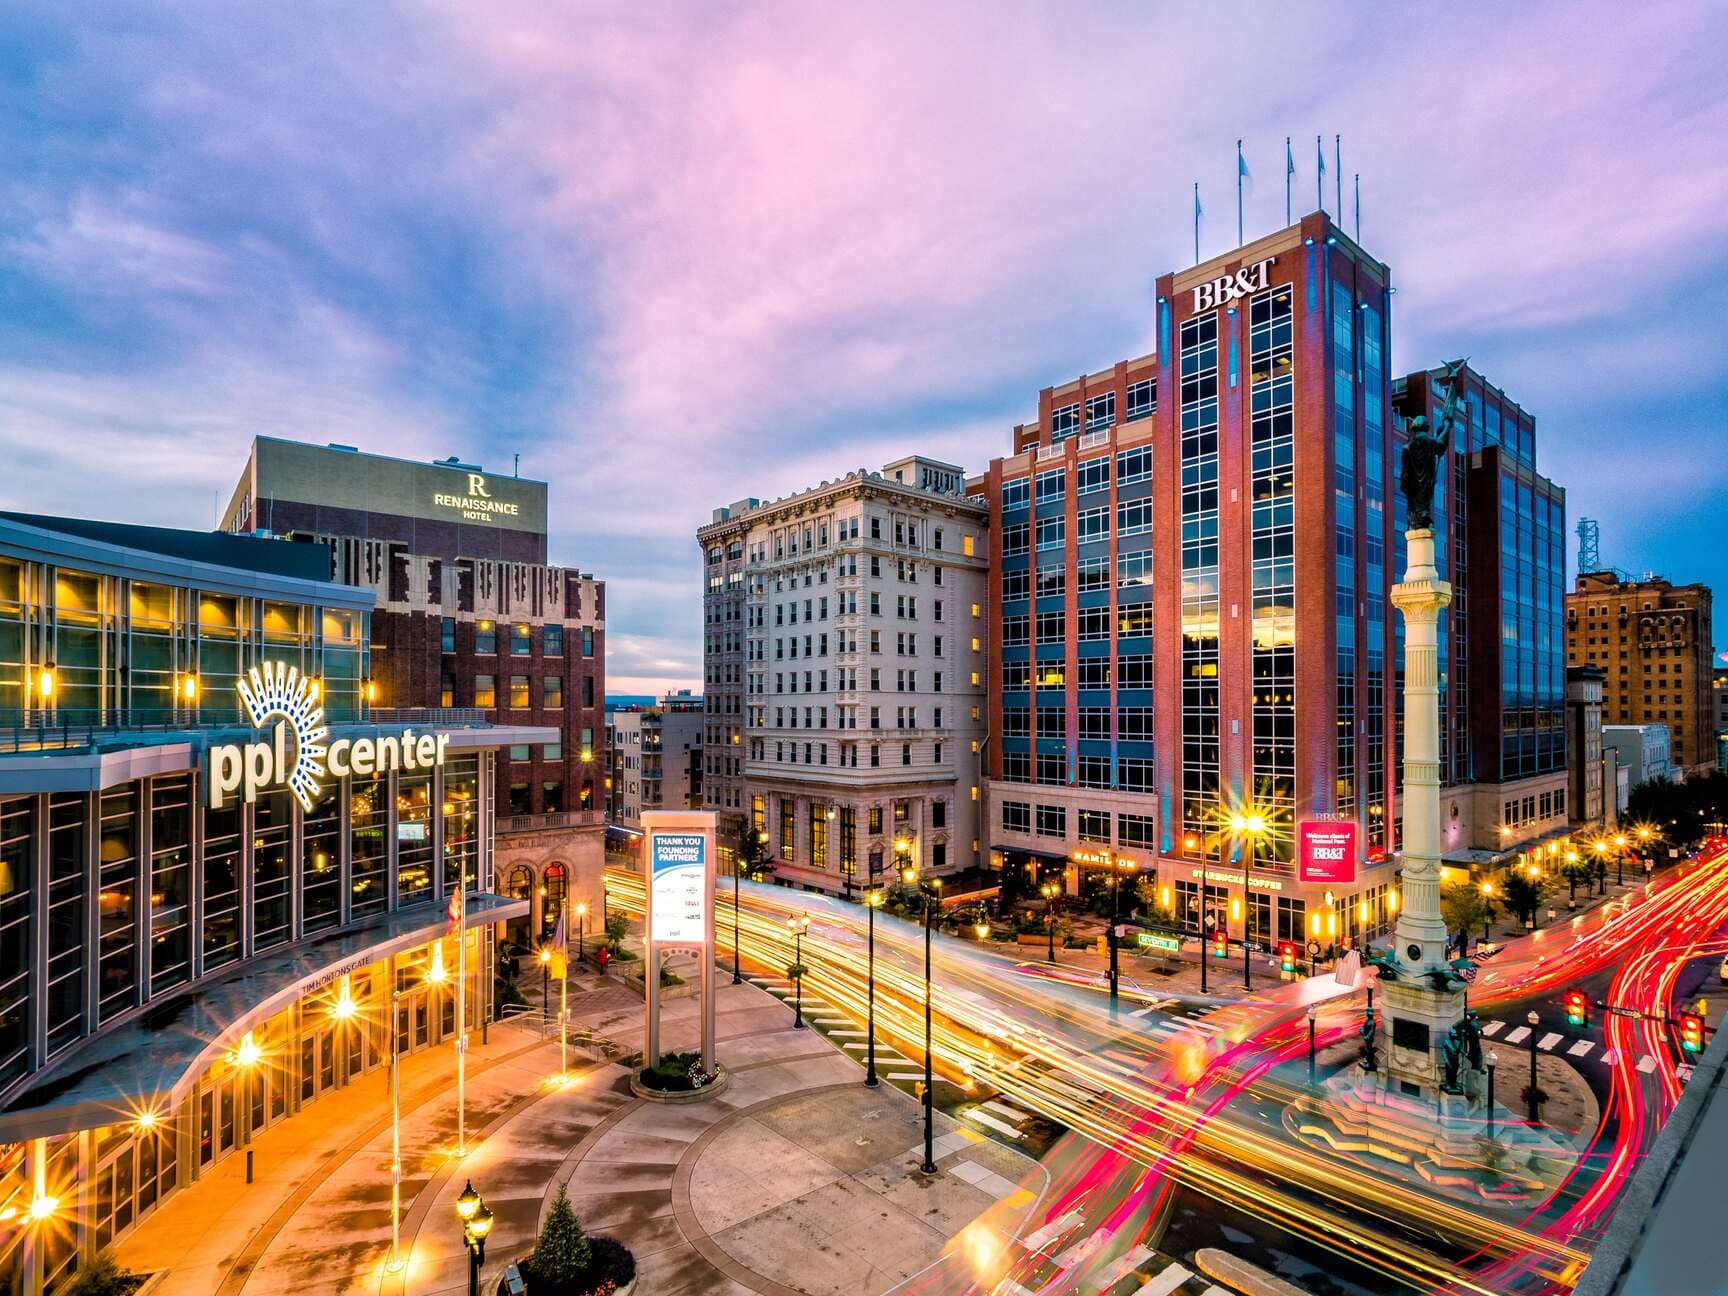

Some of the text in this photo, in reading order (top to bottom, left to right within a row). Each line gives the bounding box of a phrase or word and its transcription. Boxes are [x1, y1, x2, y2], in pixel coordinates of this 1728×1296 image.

[1192, 257, 1276, 314] BB&T
[468, 473, 491, 497] R
[434, 493, 519, 515] RENAISSANCE
[463, 510, 492, 521] HOTEL
[210, 719, 449, 809] ppl center
[656, 837, 701, 845] THANK YOU
[657, 846, 700, 854] FOUNDING
[1312, 847, 1346, 860] BB&T
[1074, 851, 1136, 867] HAMILON
[1248, 877, 1282, 890] COFFEE
[302, 956, 369, 994] TIM HORTONS GATE
